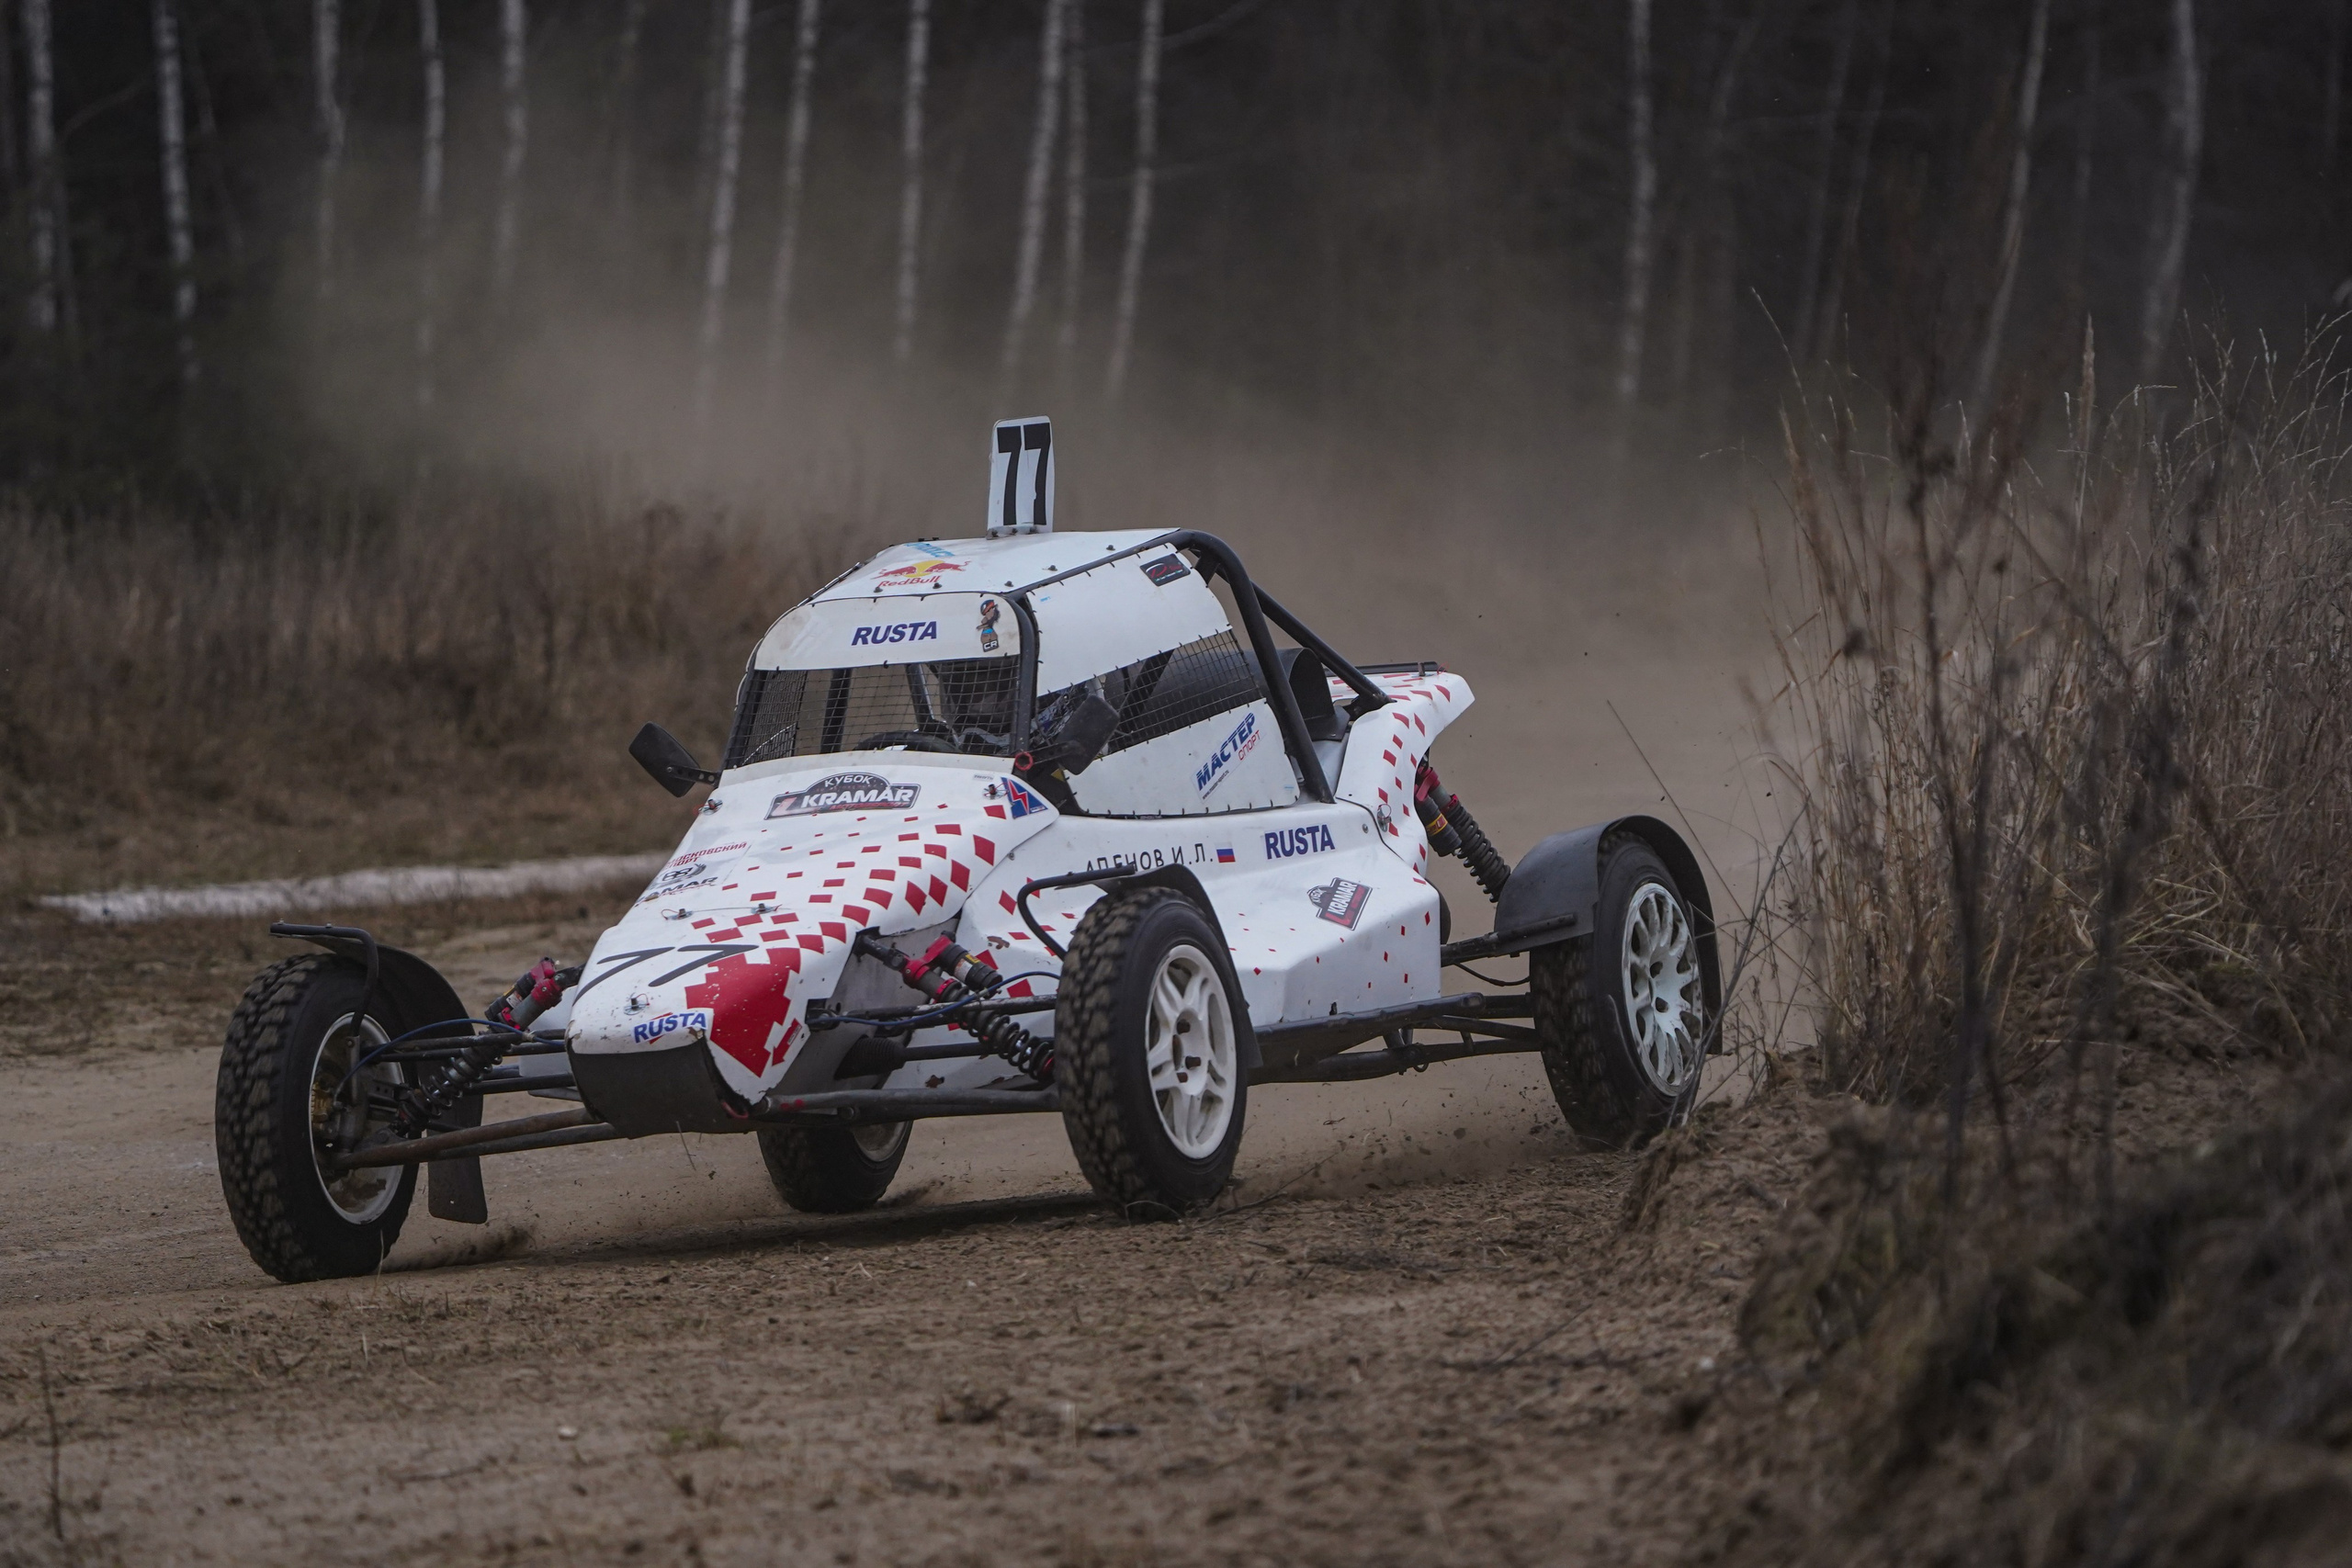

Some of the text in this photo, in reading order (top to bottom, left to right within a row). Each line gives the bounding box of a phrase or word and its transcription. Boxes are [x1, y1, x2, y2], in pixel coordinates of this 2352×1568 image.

[997, 423, 1051, 525] 77
[851, 621, 937, 646] RUSTA
[1196, 712, 1255, 791] МАСТЕР
[1238, 729, 1261, 761] СПОРТ
[825, 774, 873, 787] КУБОК
[800, 787, 914, 808] KRAMAR
[1265, 824, 1335, 860] RUSTA
[1327, 881, 1358, 916] KRAMAR
[572, 944, 760, 1007] 77
[634, 1012, 707, 1043] RUSTA
